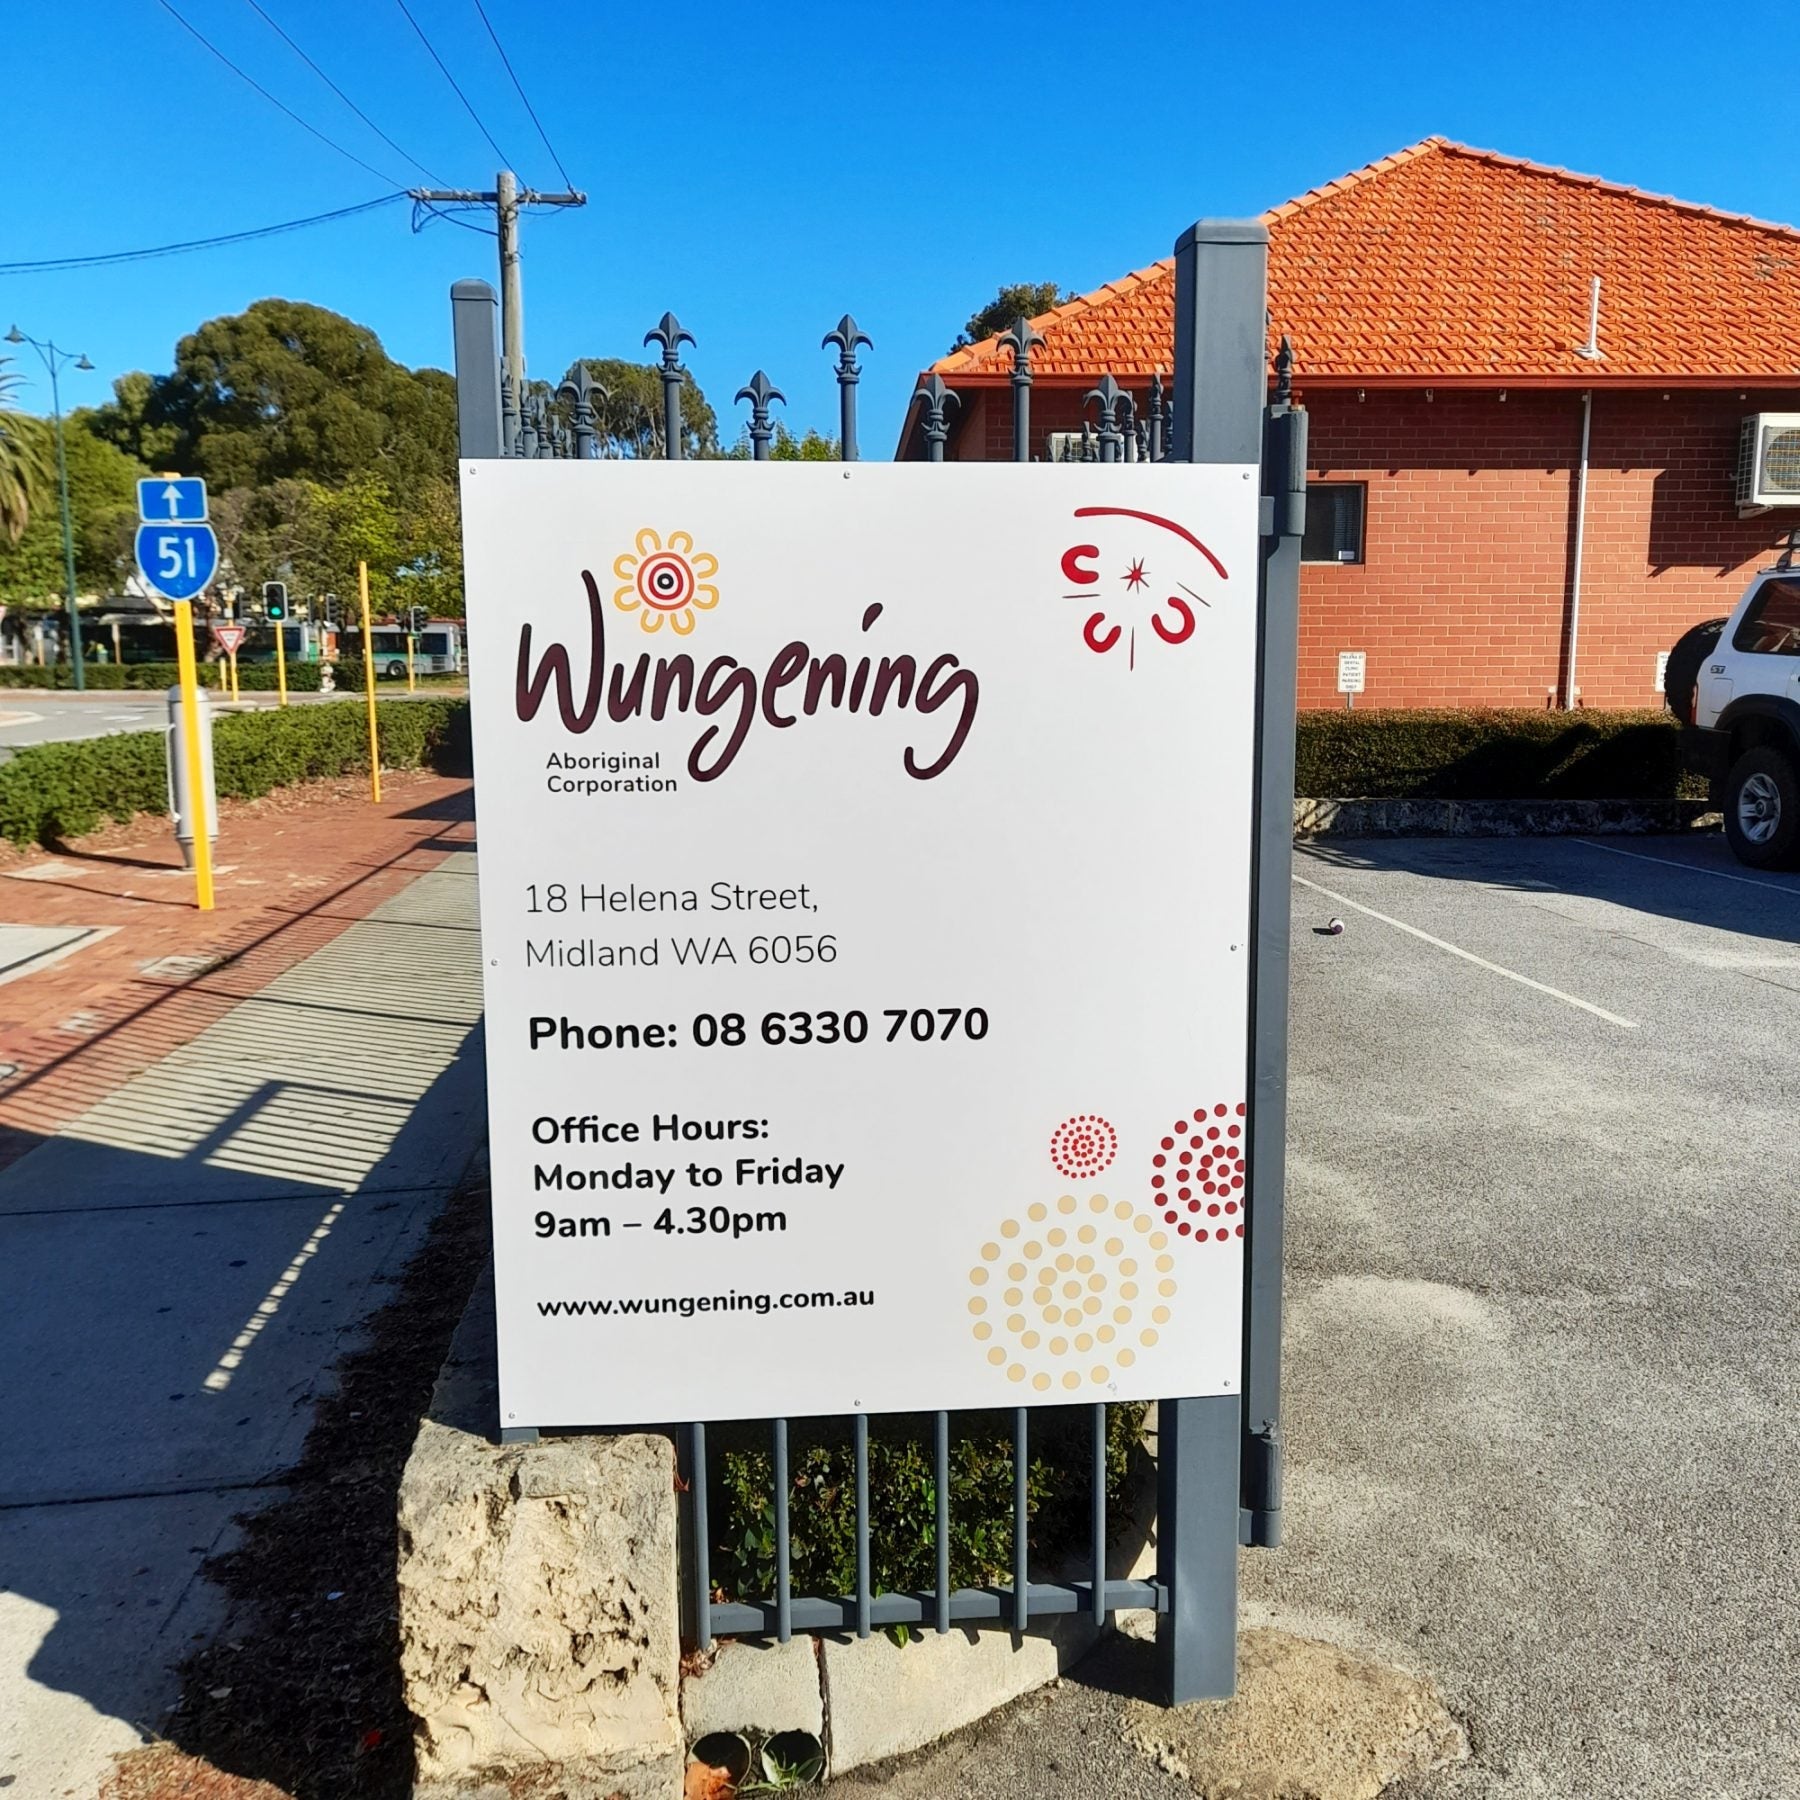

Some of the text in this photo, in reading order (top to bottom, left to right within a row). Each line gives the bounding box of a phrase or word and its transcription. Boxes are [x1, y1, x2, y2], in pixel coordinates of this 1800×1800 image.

[158, 536, 197, 579] 51
[515, 569, 980, 782] Wungening
[546, 751, 660, 773] Aboriginal
[547, 775, 677, 797] Corporation
[526, 882, 818, 913] 18 Helena Street,
[526, 934, 838, 968] Midland WA 6056
[529, 1007, 989, 1050] Phone: 08 6330 7070
[531, 1113, 769, 1145] Office Hours:
[534, 1157, 845, 1195] Monday to Friday
[534, 1211, 611, 1239] 9am
[653, 1206, 787, 1240] 4.30pm
[536, 1289, 875, 1318] www.wungening.com.au
